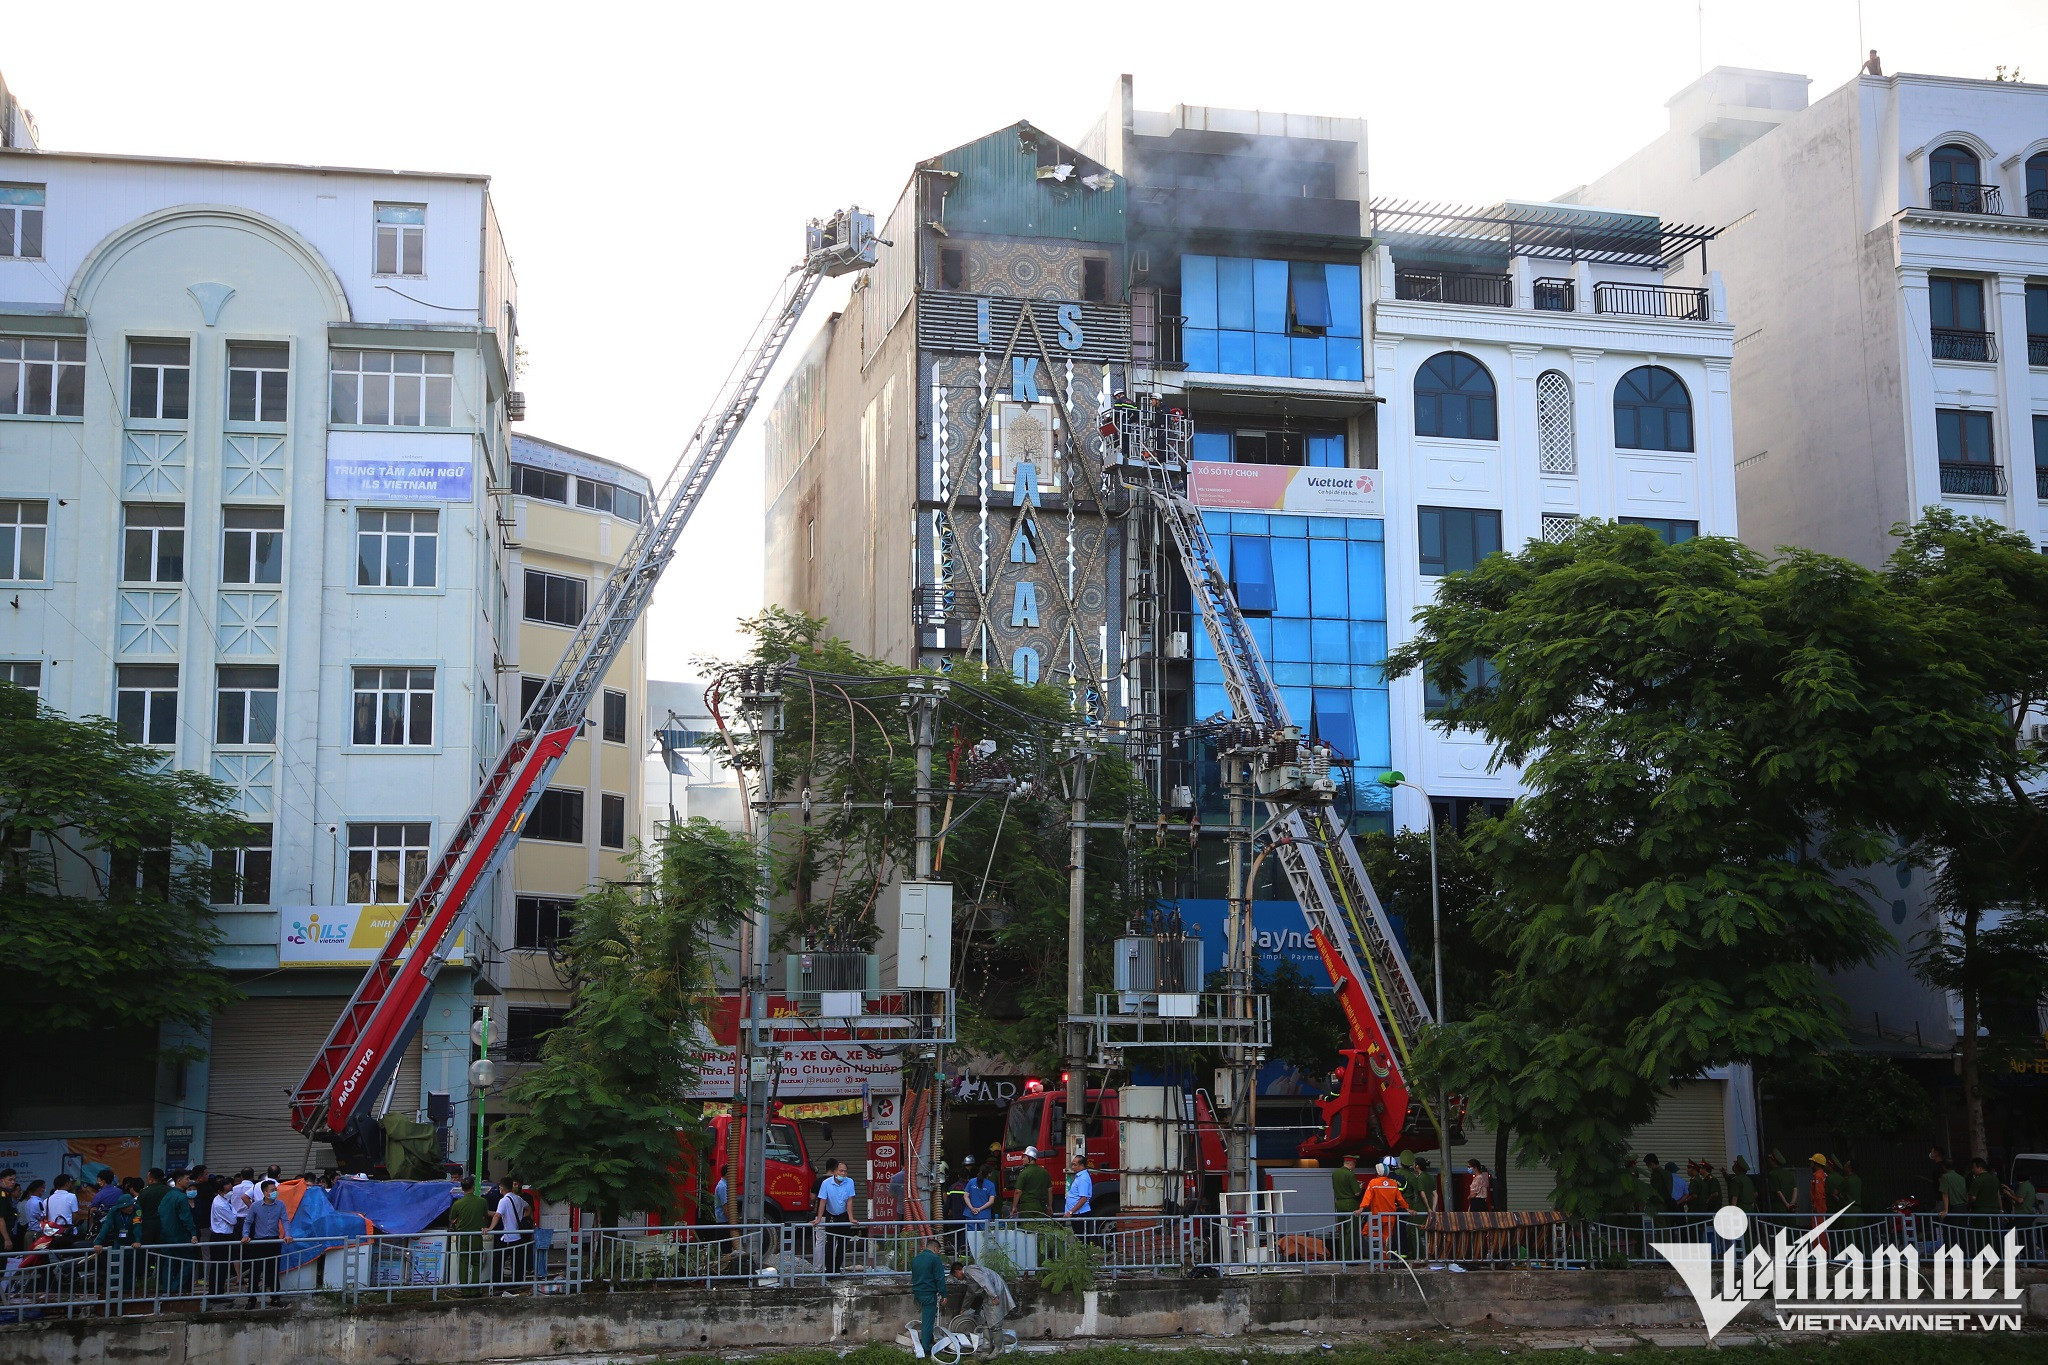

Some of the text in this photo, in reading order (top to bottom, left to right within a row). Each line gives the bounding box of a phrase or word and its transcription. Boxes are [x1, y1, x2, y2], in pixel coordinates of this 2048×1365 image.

[334, 466, 375, 476] TRUNG
[379, 467, 405, 477] TÂM
[408, 468, 434, 477] ANH
[1210, 465, 1221, 476] SỐ
[1235, 469, 1259, 479] CHỌN
[362, 480, 437, 490] ILS VIETNAM
[1307, 477, 1354, 489] Vietlott
[370, 920, 391, 928] ANH
[319, 923, 348, 939] ILS
[801, 1051, 816, 1061] XE
[847, 1050, 862, 1060] XE
[802, 1063, 851, 1075] Chuyên
[854, 1062, 898, 1076] Nghiệp
[338, 1048, 374, 1107] MORITA
[874, 1133, 897, 1141] Havoline
[873, 1160, 897, 1171] Chuyên
[876, 1172, 884, 1180] Xe
[876, 1184, 884, 1192] Xe
